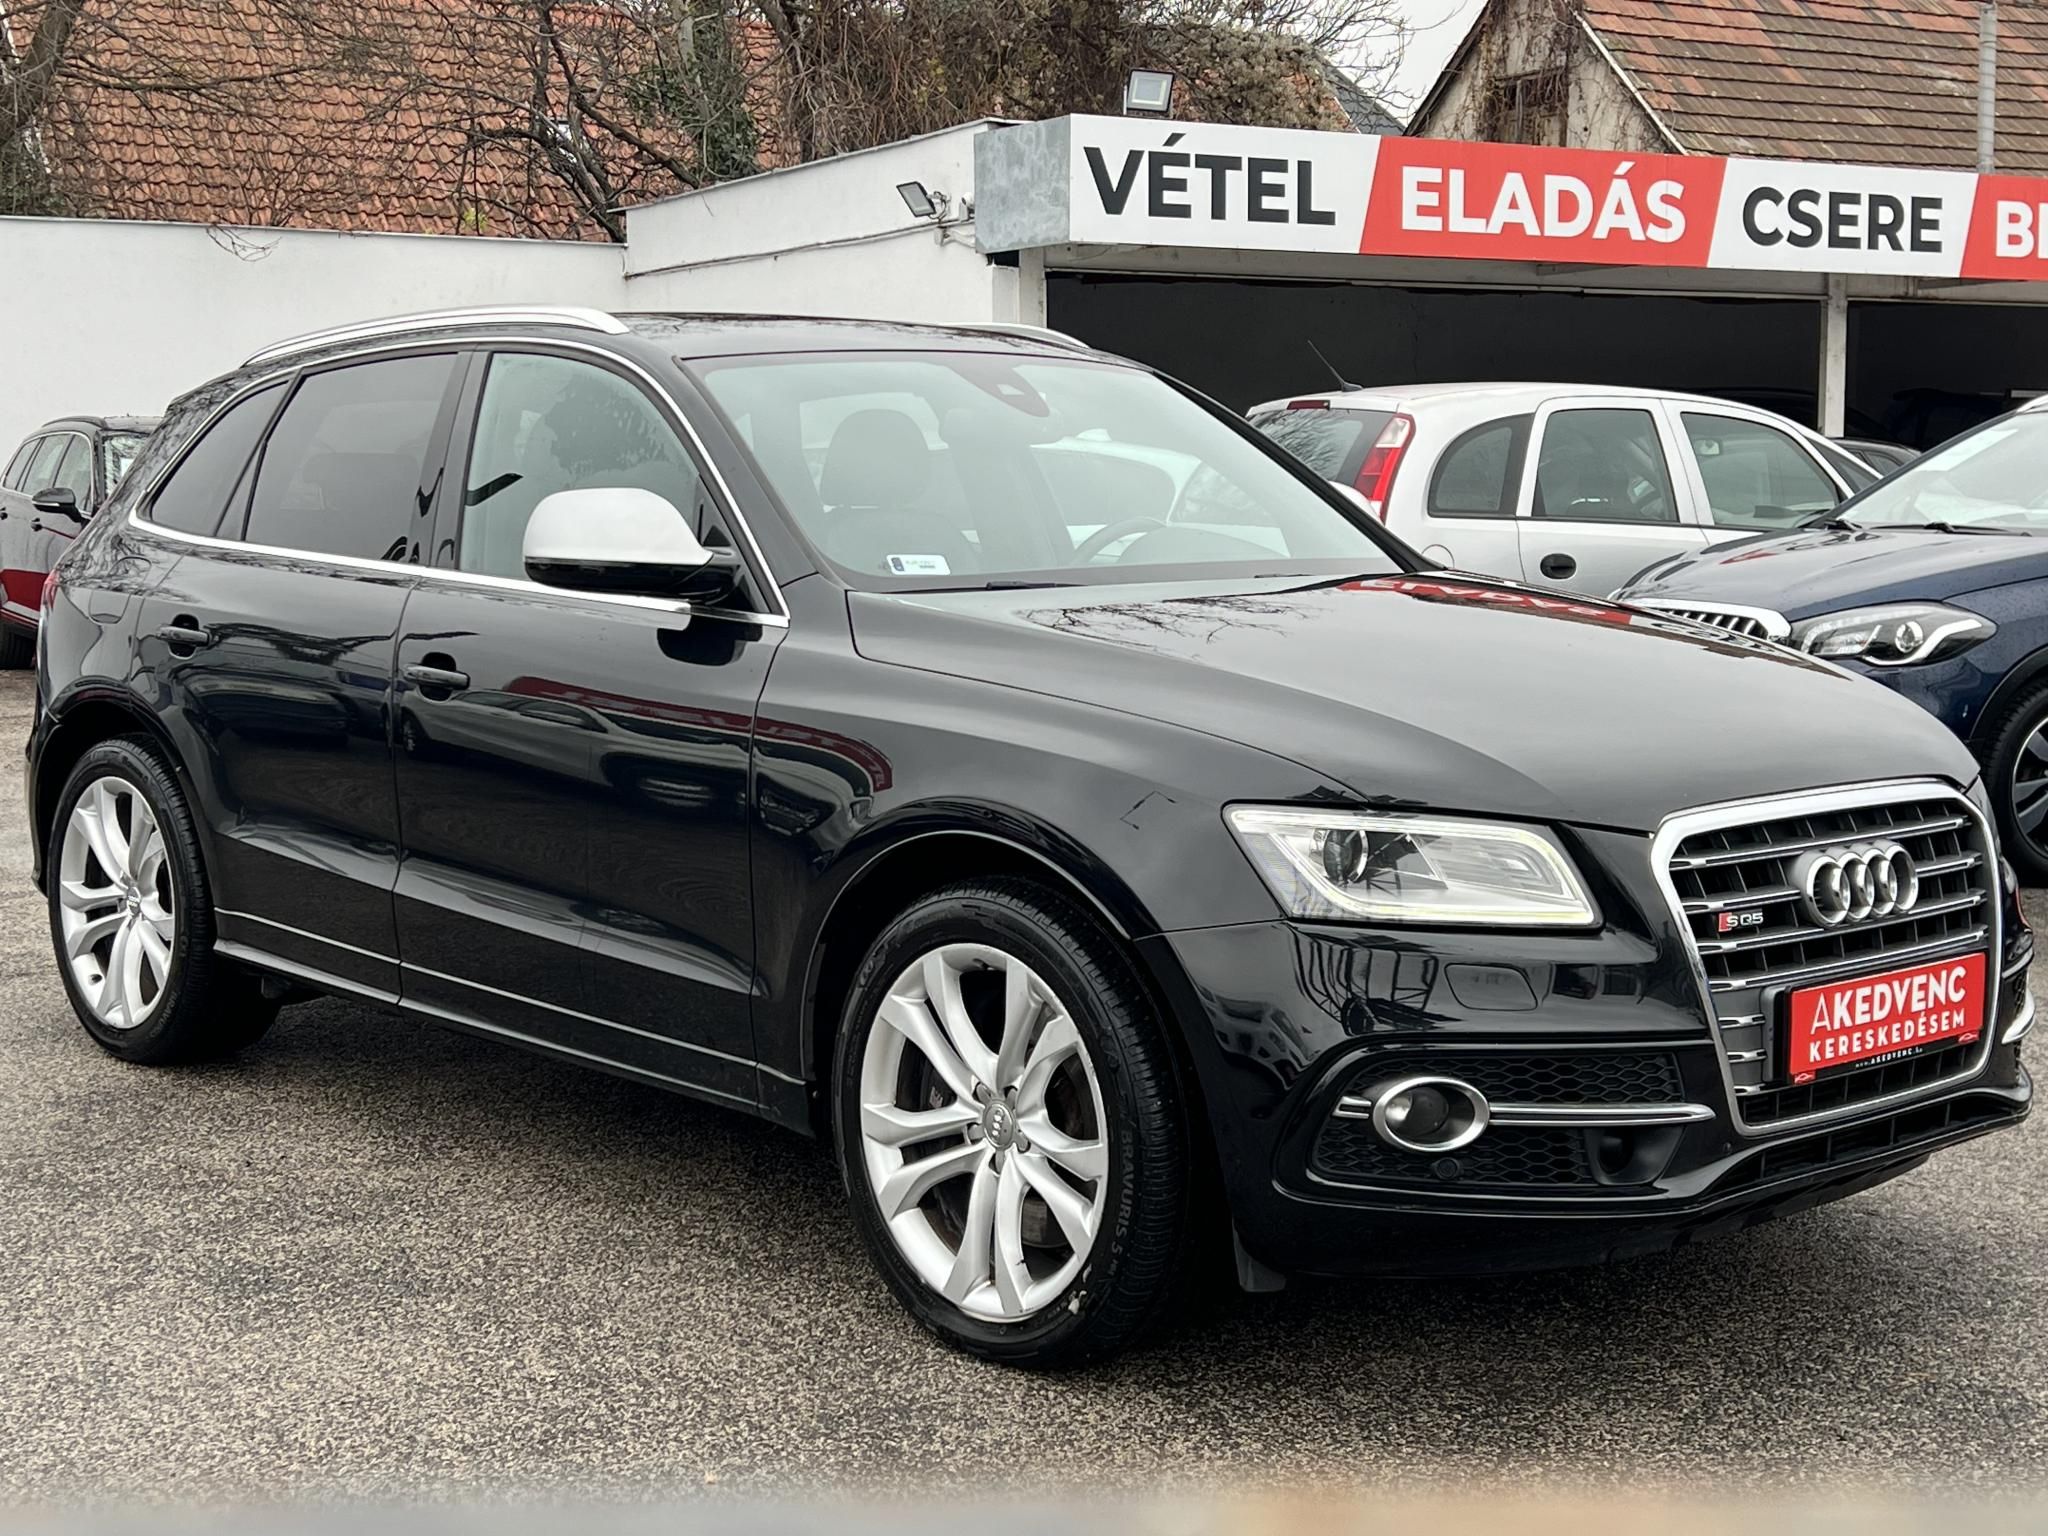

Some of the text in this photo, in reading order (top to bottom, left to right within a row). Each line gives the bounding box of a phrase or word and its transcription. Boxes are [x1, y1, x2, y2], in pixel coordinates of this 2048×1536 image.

[1084, 132, 1336, 226] VÉTEL
[1401, 162, 1686, 243] ELADÁS
[1742, 186, 1943, 253] CSERE
[1725, 911, 1764, 928] SQ5
[1809, 1008, 1966, 1063] KERESKEDÉSEM
